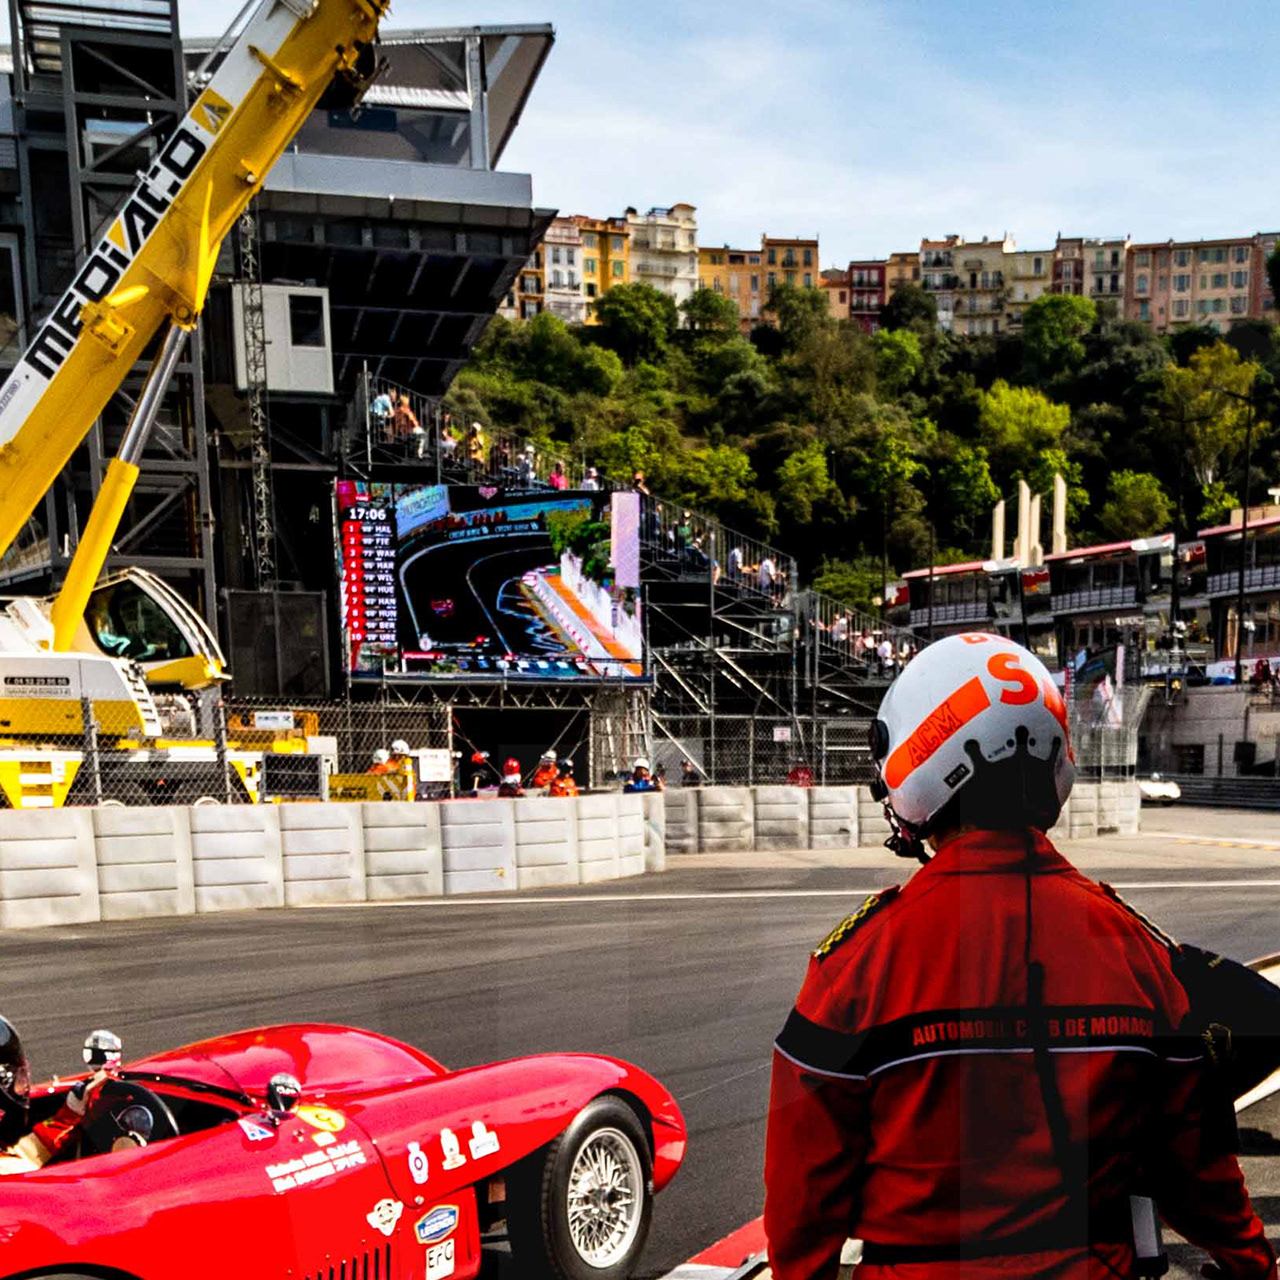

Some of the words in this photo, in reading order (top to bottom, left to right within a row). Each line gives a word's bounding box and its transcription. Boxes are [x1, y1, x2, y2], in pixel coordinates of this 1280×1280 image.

[349, 507, 387, 520] 17:06
[910, 700, 963, 768] ACM
[1065, 1018, 1088, 1037] DE
